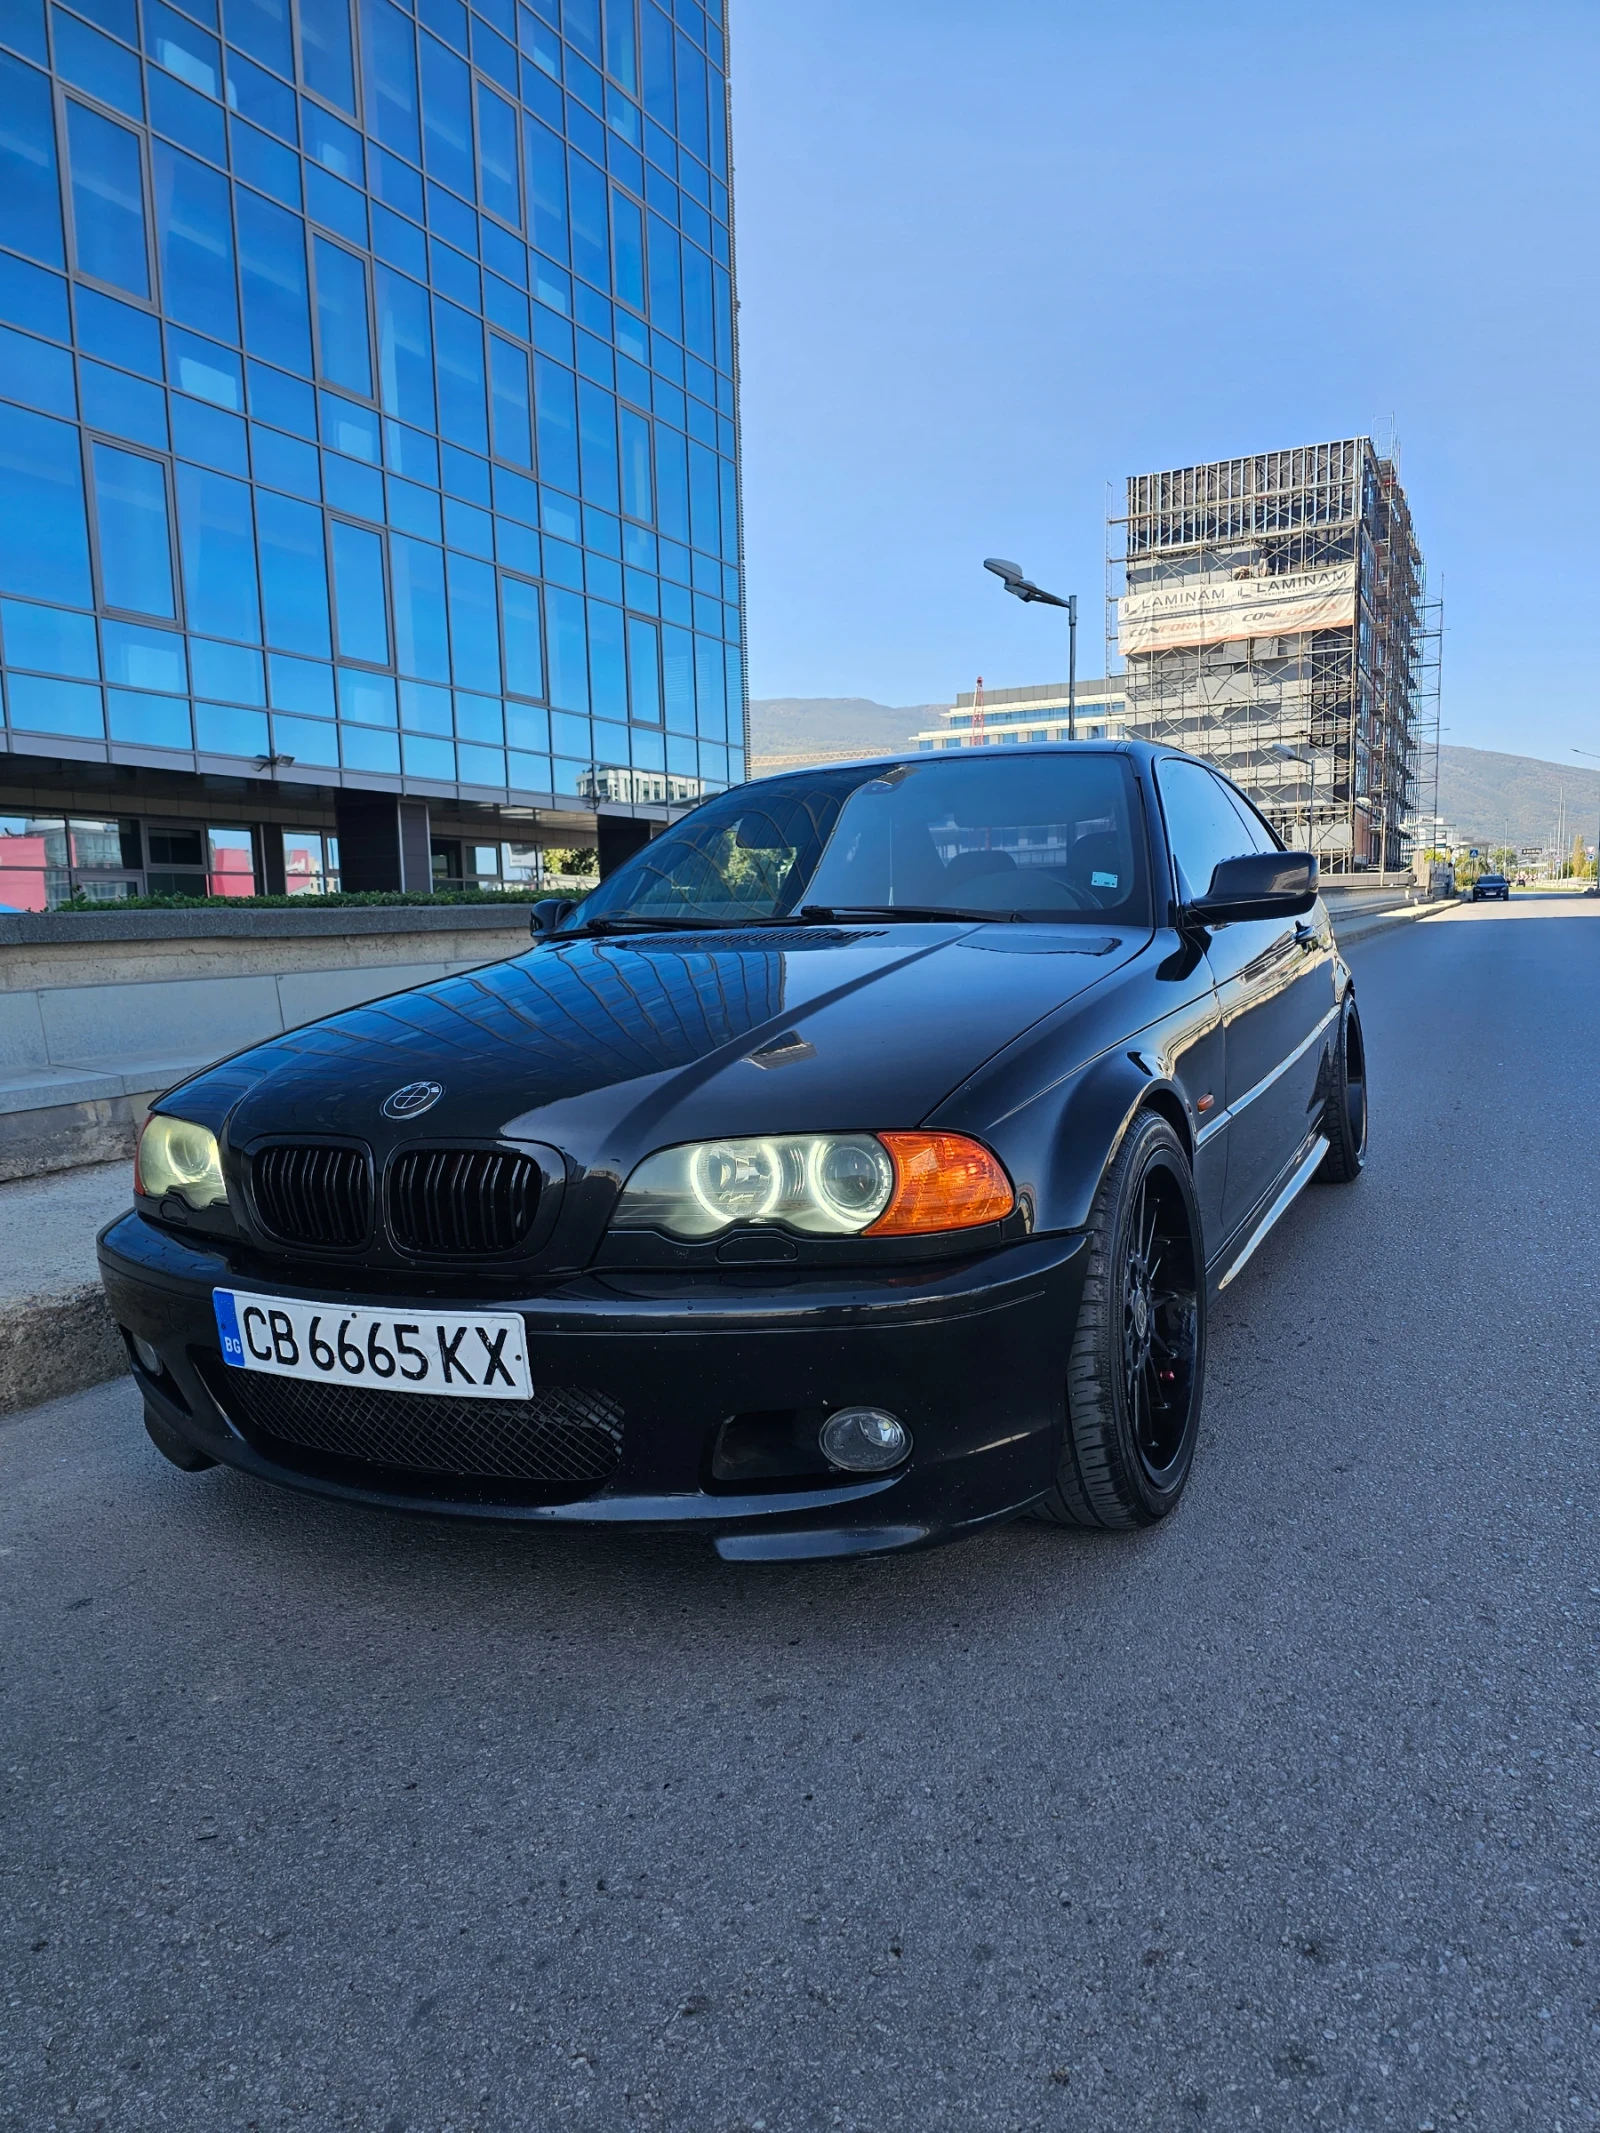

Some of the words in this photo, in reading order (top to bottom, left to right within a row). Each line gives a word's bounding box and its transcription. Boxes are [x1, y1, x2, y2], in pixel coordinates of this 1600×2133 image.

[1256, 570, 1347, 593] LAMINAM
[1142, 588, 1225, 609] LAMINAM
[224, 1336, 241, 1354] BG
[243, 1305, 300, 1366] CB
[308, 1316, 429, 1381] 6665
[436, 1325, 516, 1387] KX
